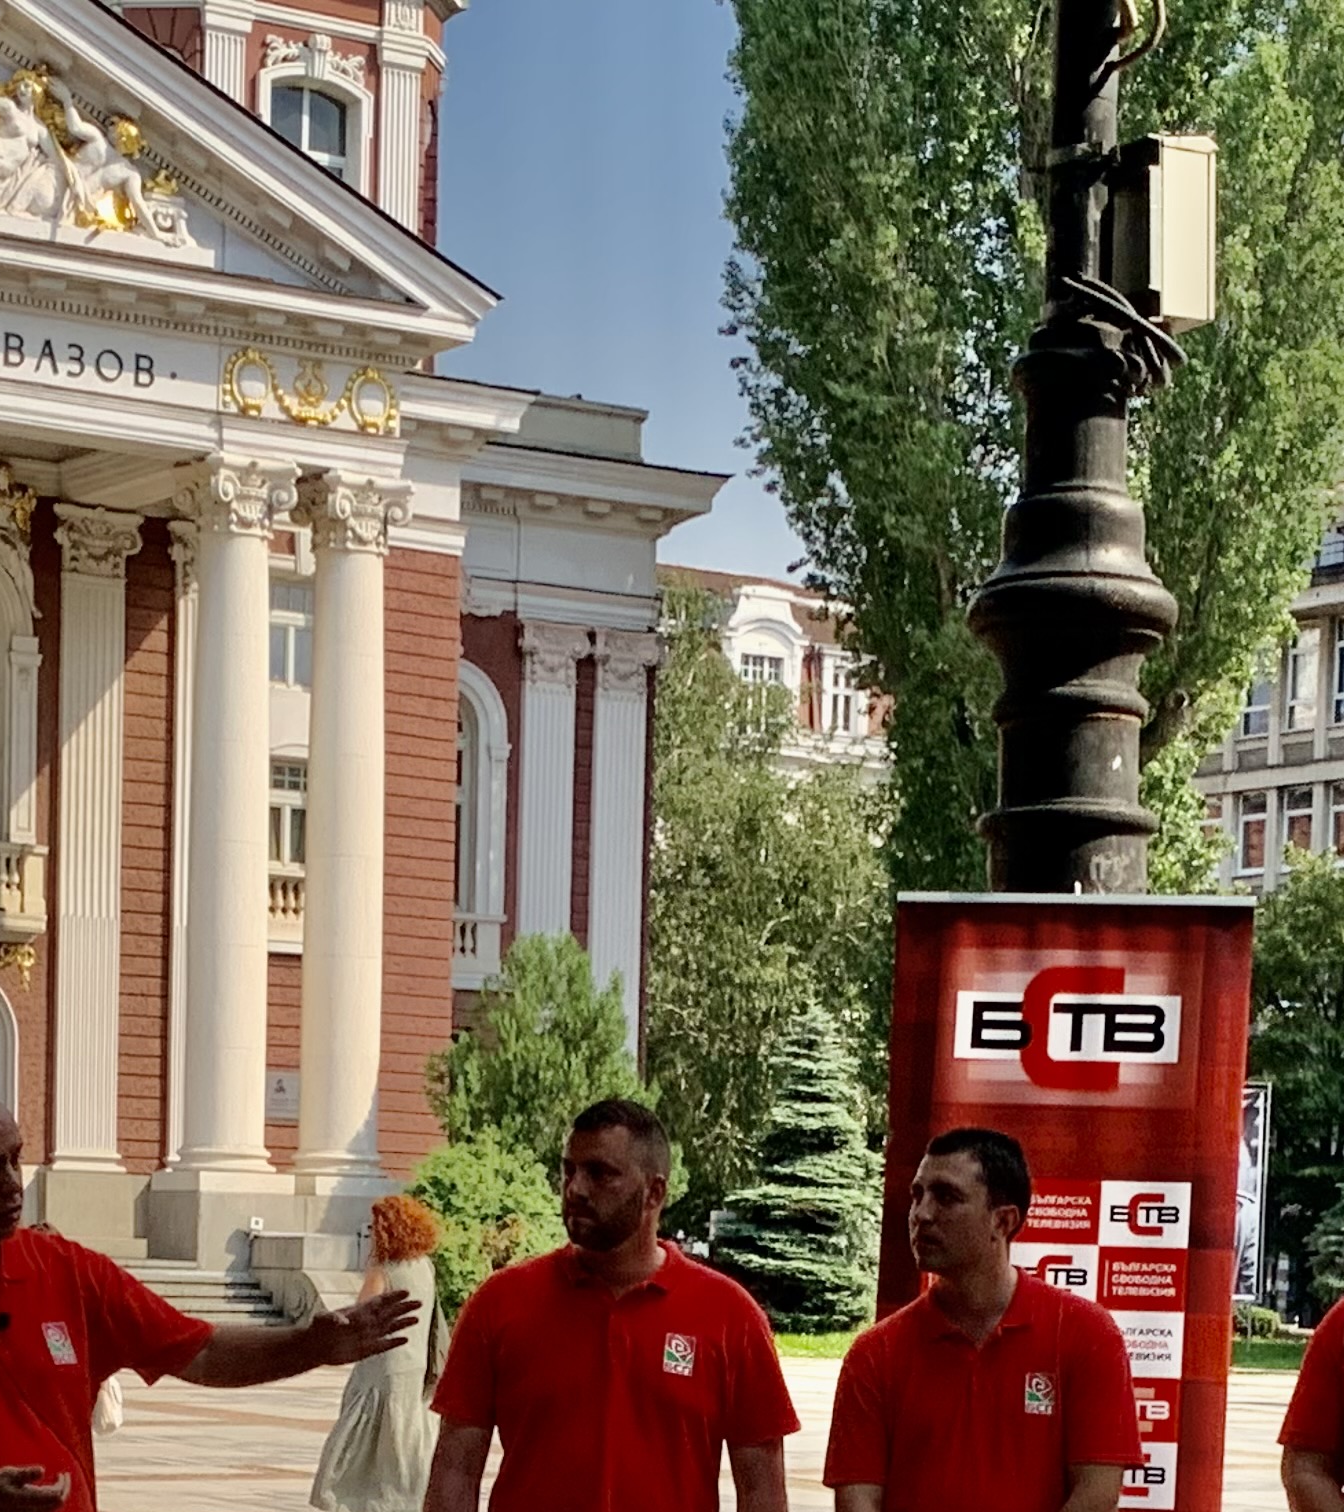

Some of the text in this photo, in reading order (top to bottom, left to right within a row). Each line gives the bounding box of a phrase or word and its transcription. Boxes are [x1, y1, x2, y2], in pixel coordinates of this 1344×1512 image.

[3, 332, 155, 388] ВАЗОВ
[1112, 1262, 1177, 1273] БЪЛГАРСКА
[1112, 1274, 1173, 1285] СВОБОДНА
[1112, 1285, 1176, 1297] ТЕЛЕВИЗИЯ
